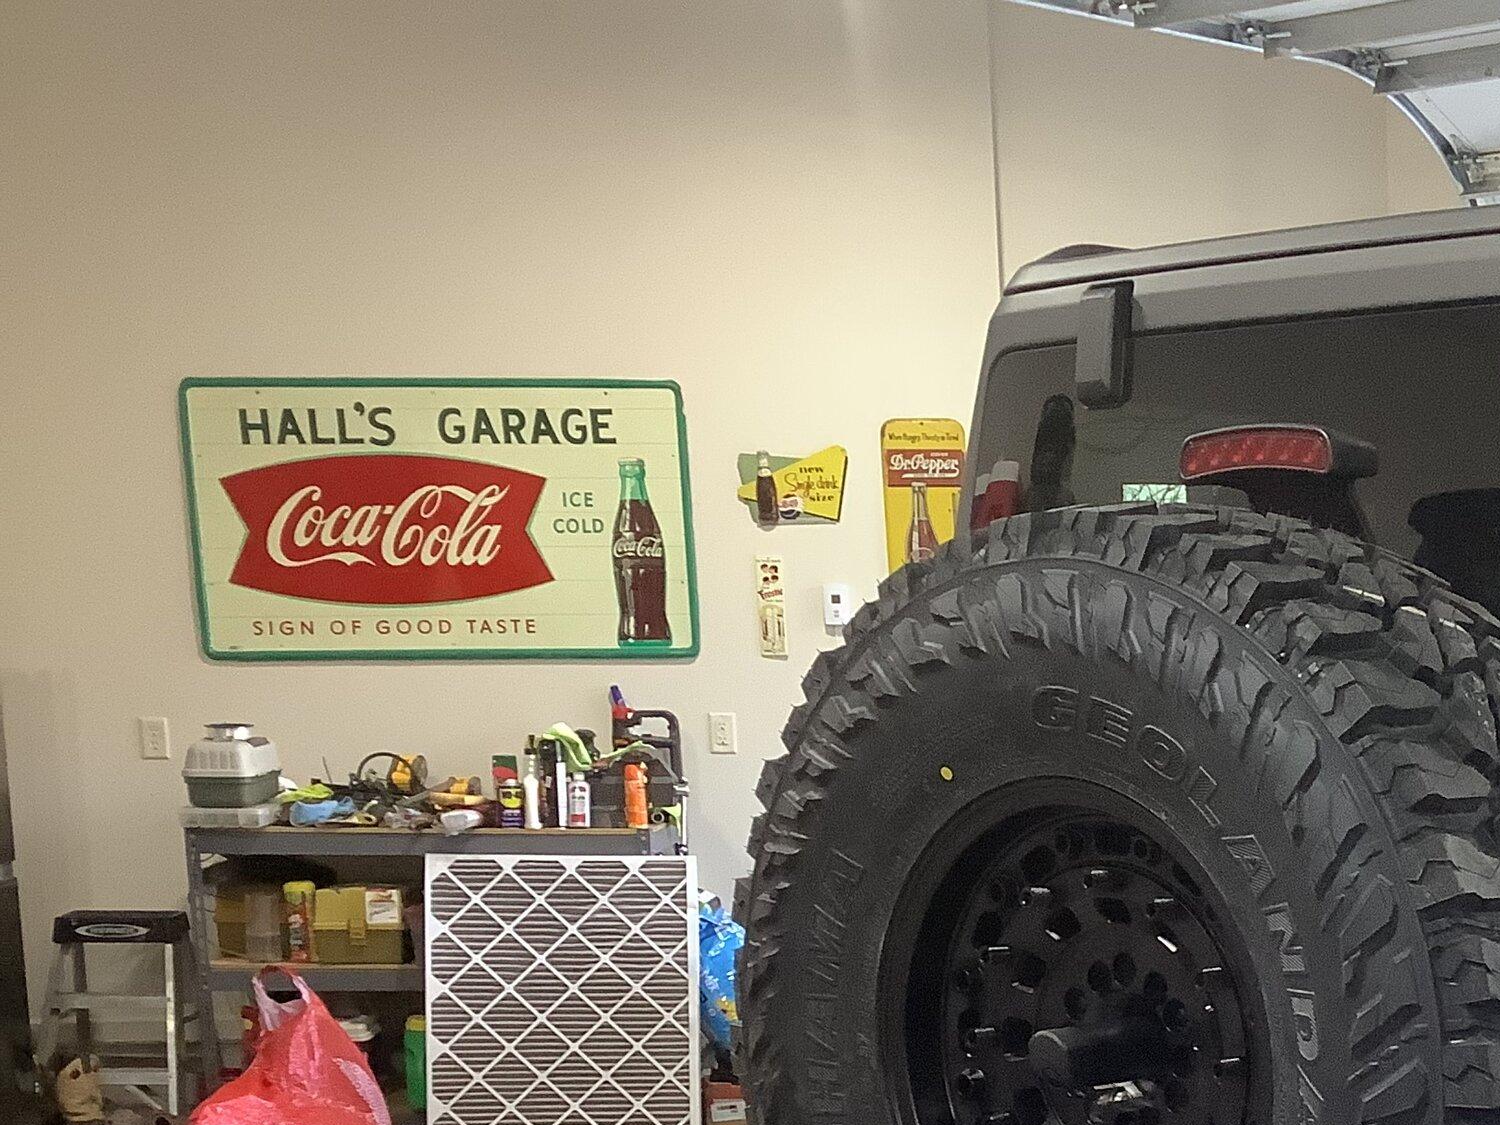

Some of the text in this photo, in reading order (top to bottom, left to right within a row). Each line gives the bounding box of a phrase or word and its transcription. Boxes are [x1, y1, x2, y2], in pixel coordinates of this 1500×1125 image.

[238, 402, 618, 446] HALL'S GARAGE
[798, 466, 824, 474] new
[784, 472, 840, 498] Single drink
[561, 491, 594, 508] ICE
[809, 492, 835, 502] size
[266, 484, 511, 567] Coca-Cola
[553, 517, 605, 535] COLD
[252, 619, 537, 637] SIGN OF GOOD TASTE
